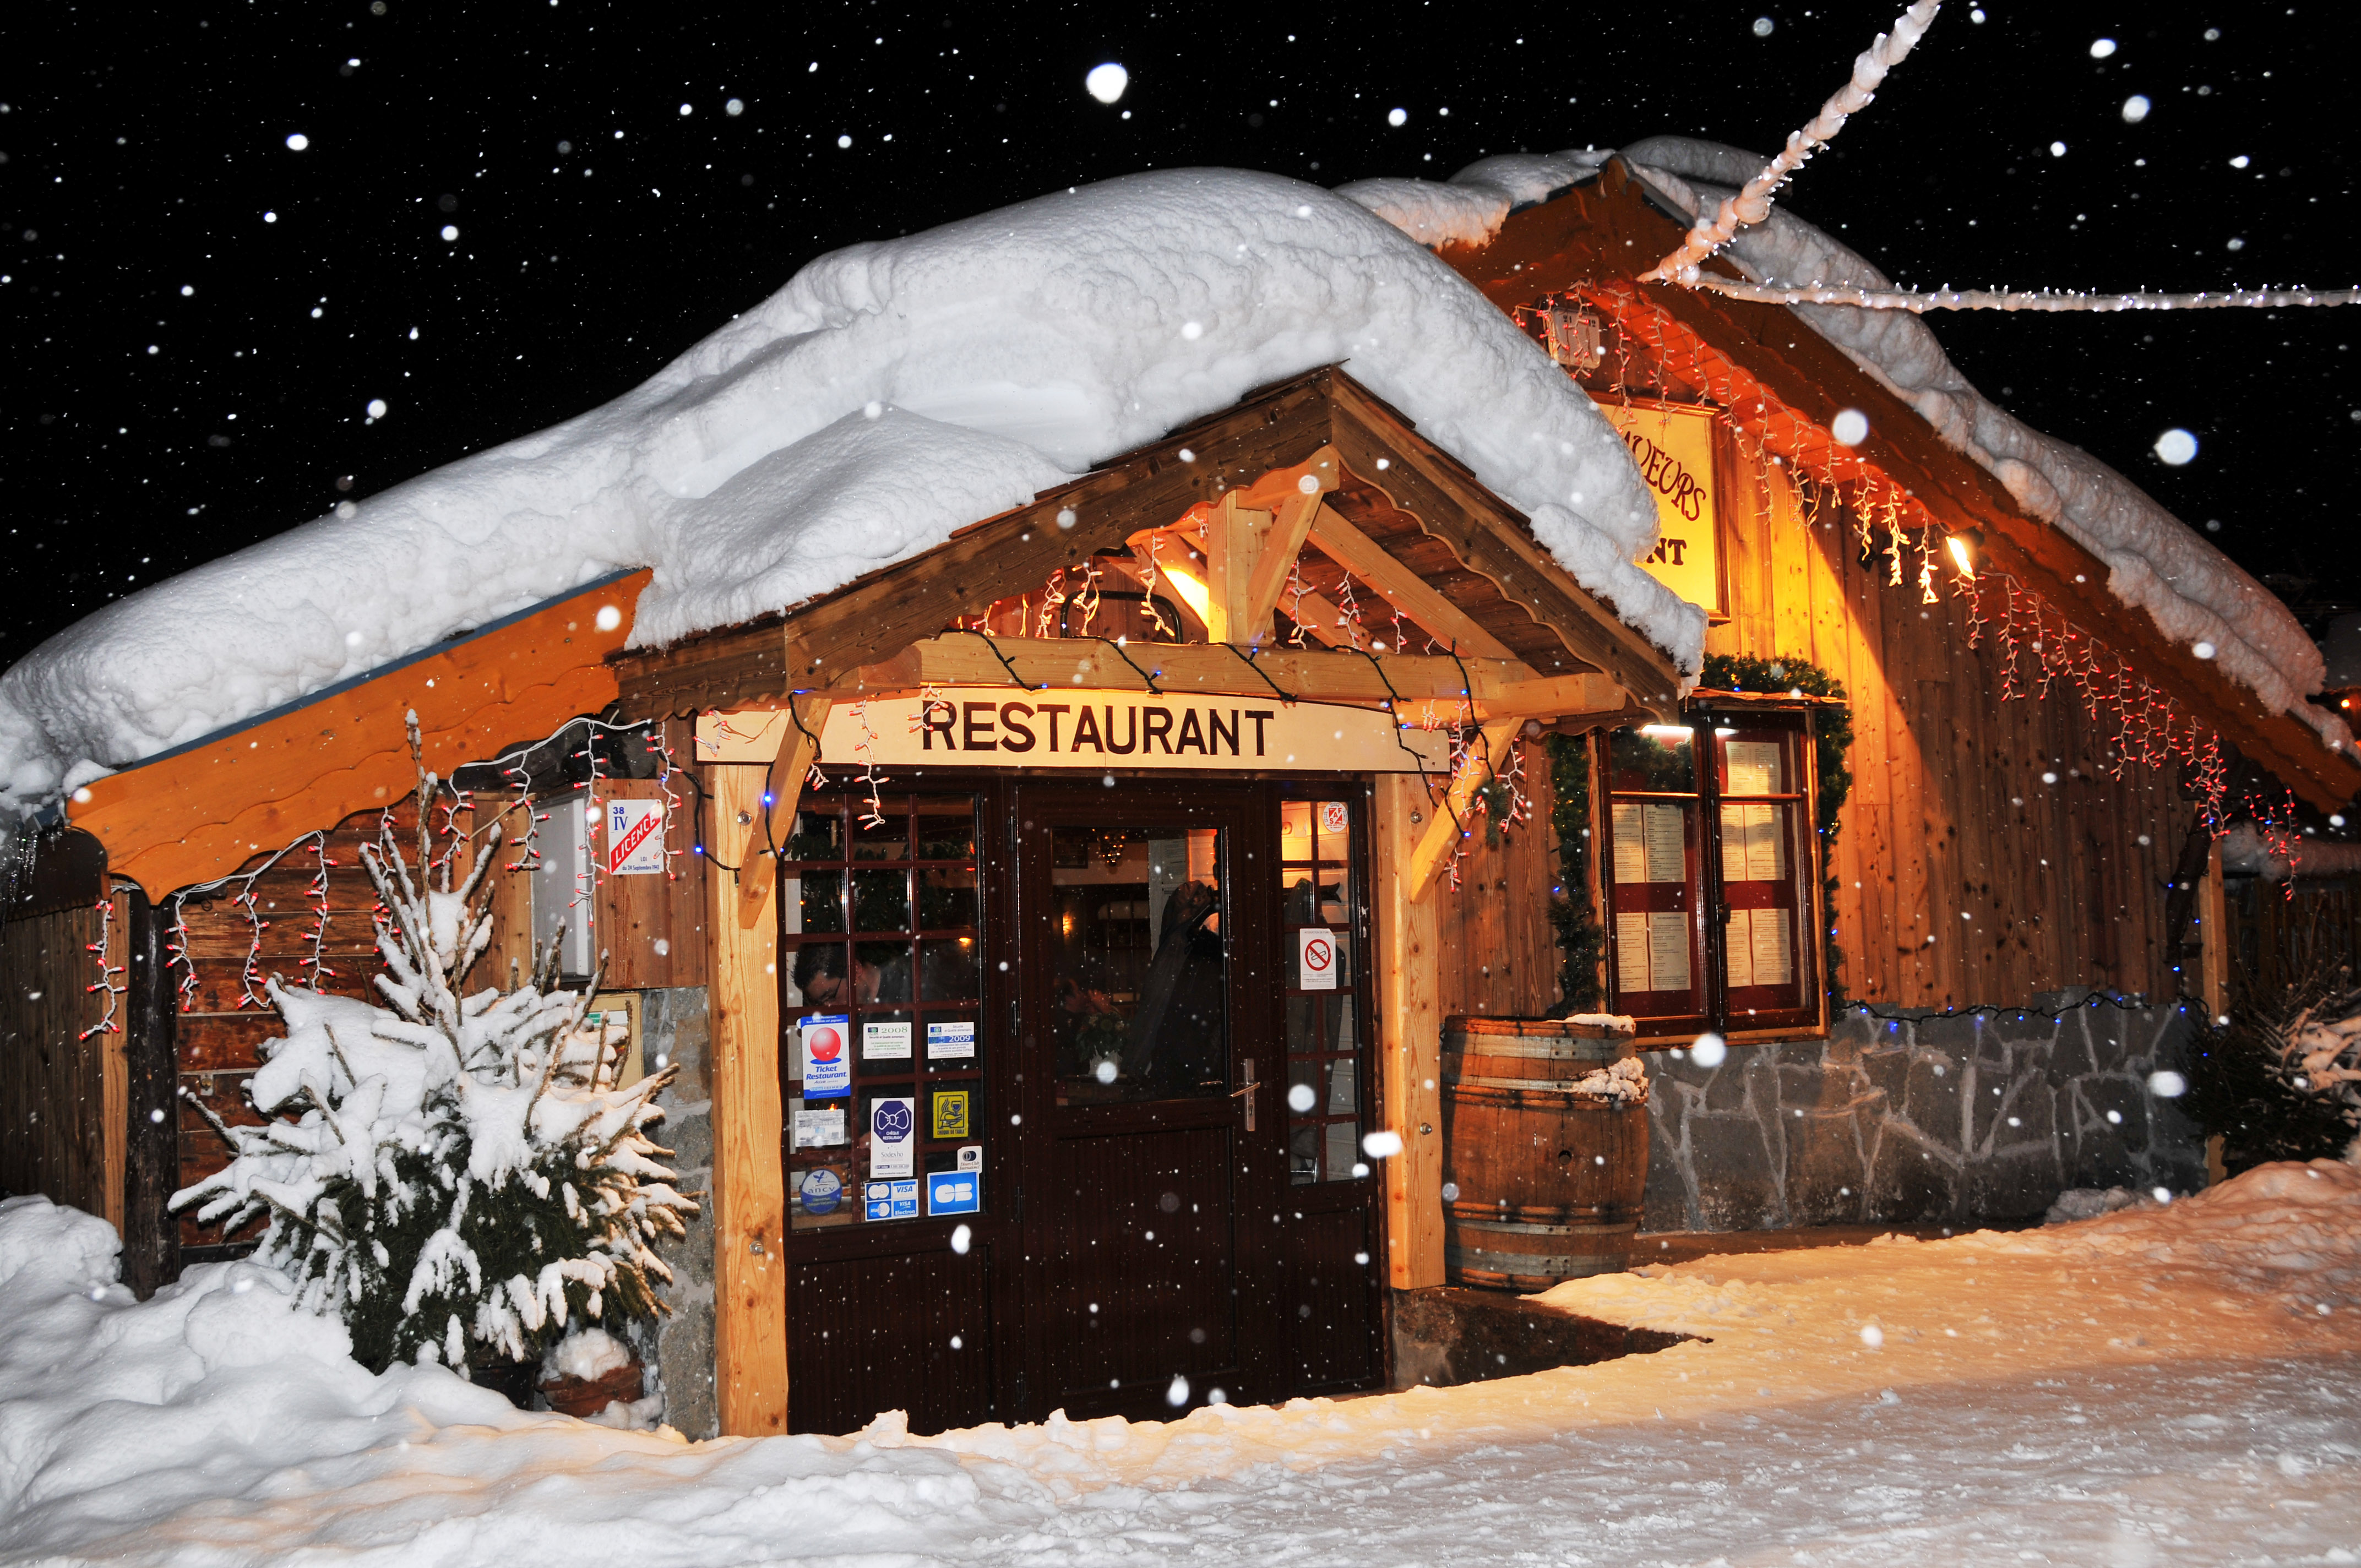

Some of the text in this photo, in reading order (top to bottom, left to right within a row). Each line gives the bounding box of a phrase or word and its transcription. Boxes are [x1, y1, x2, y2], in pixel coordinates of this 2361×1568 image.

[922, 700, 1275, 756] RESTAURANT
[614, 816, 628, 830] IV
[615, 814, 656, 864] LICENCE
[806, 1072, 847, 1080] Restaurant
